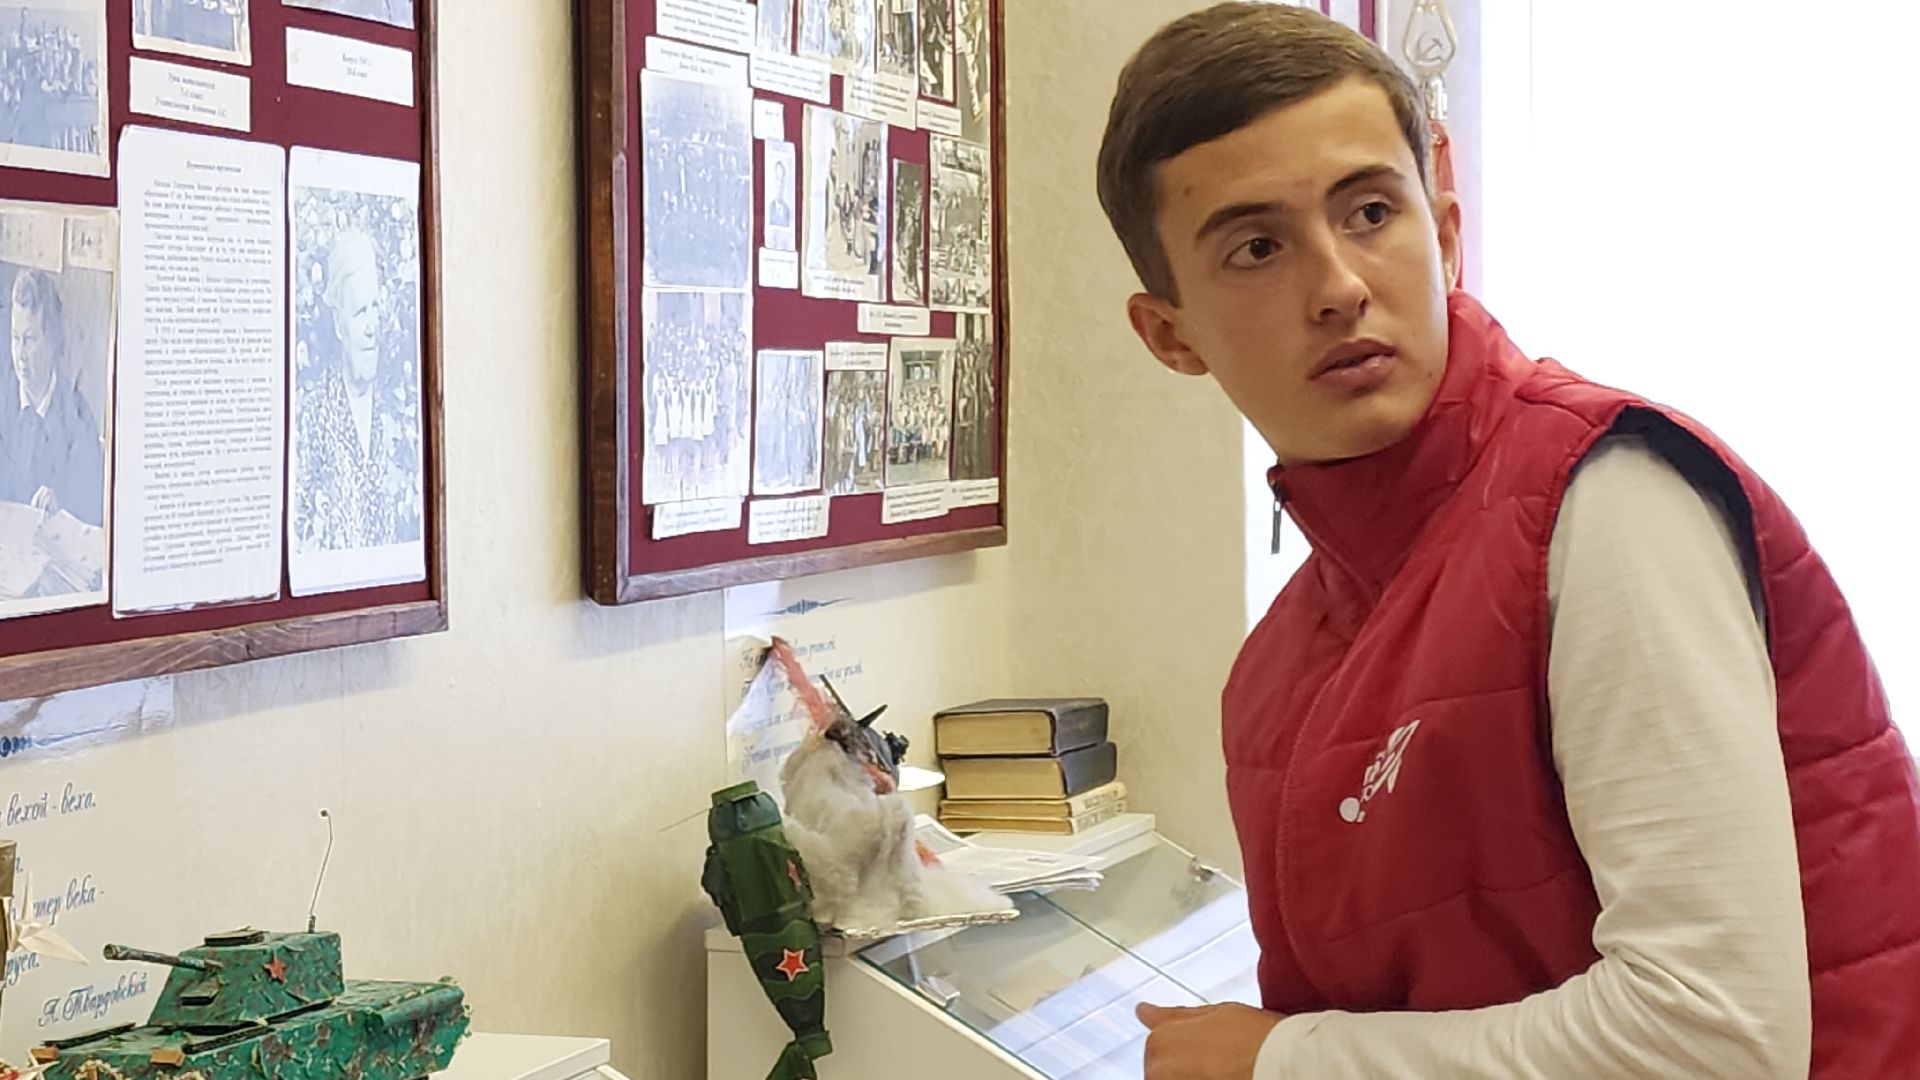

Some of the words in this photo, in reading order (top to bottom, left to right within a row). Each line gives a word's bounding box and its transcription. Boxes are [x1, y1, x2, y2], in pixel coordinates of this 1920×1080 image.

[7, 792, 48, 826] вехой
[60, 781, 96, 814] веха.
[66, 873, 96, 912] века
